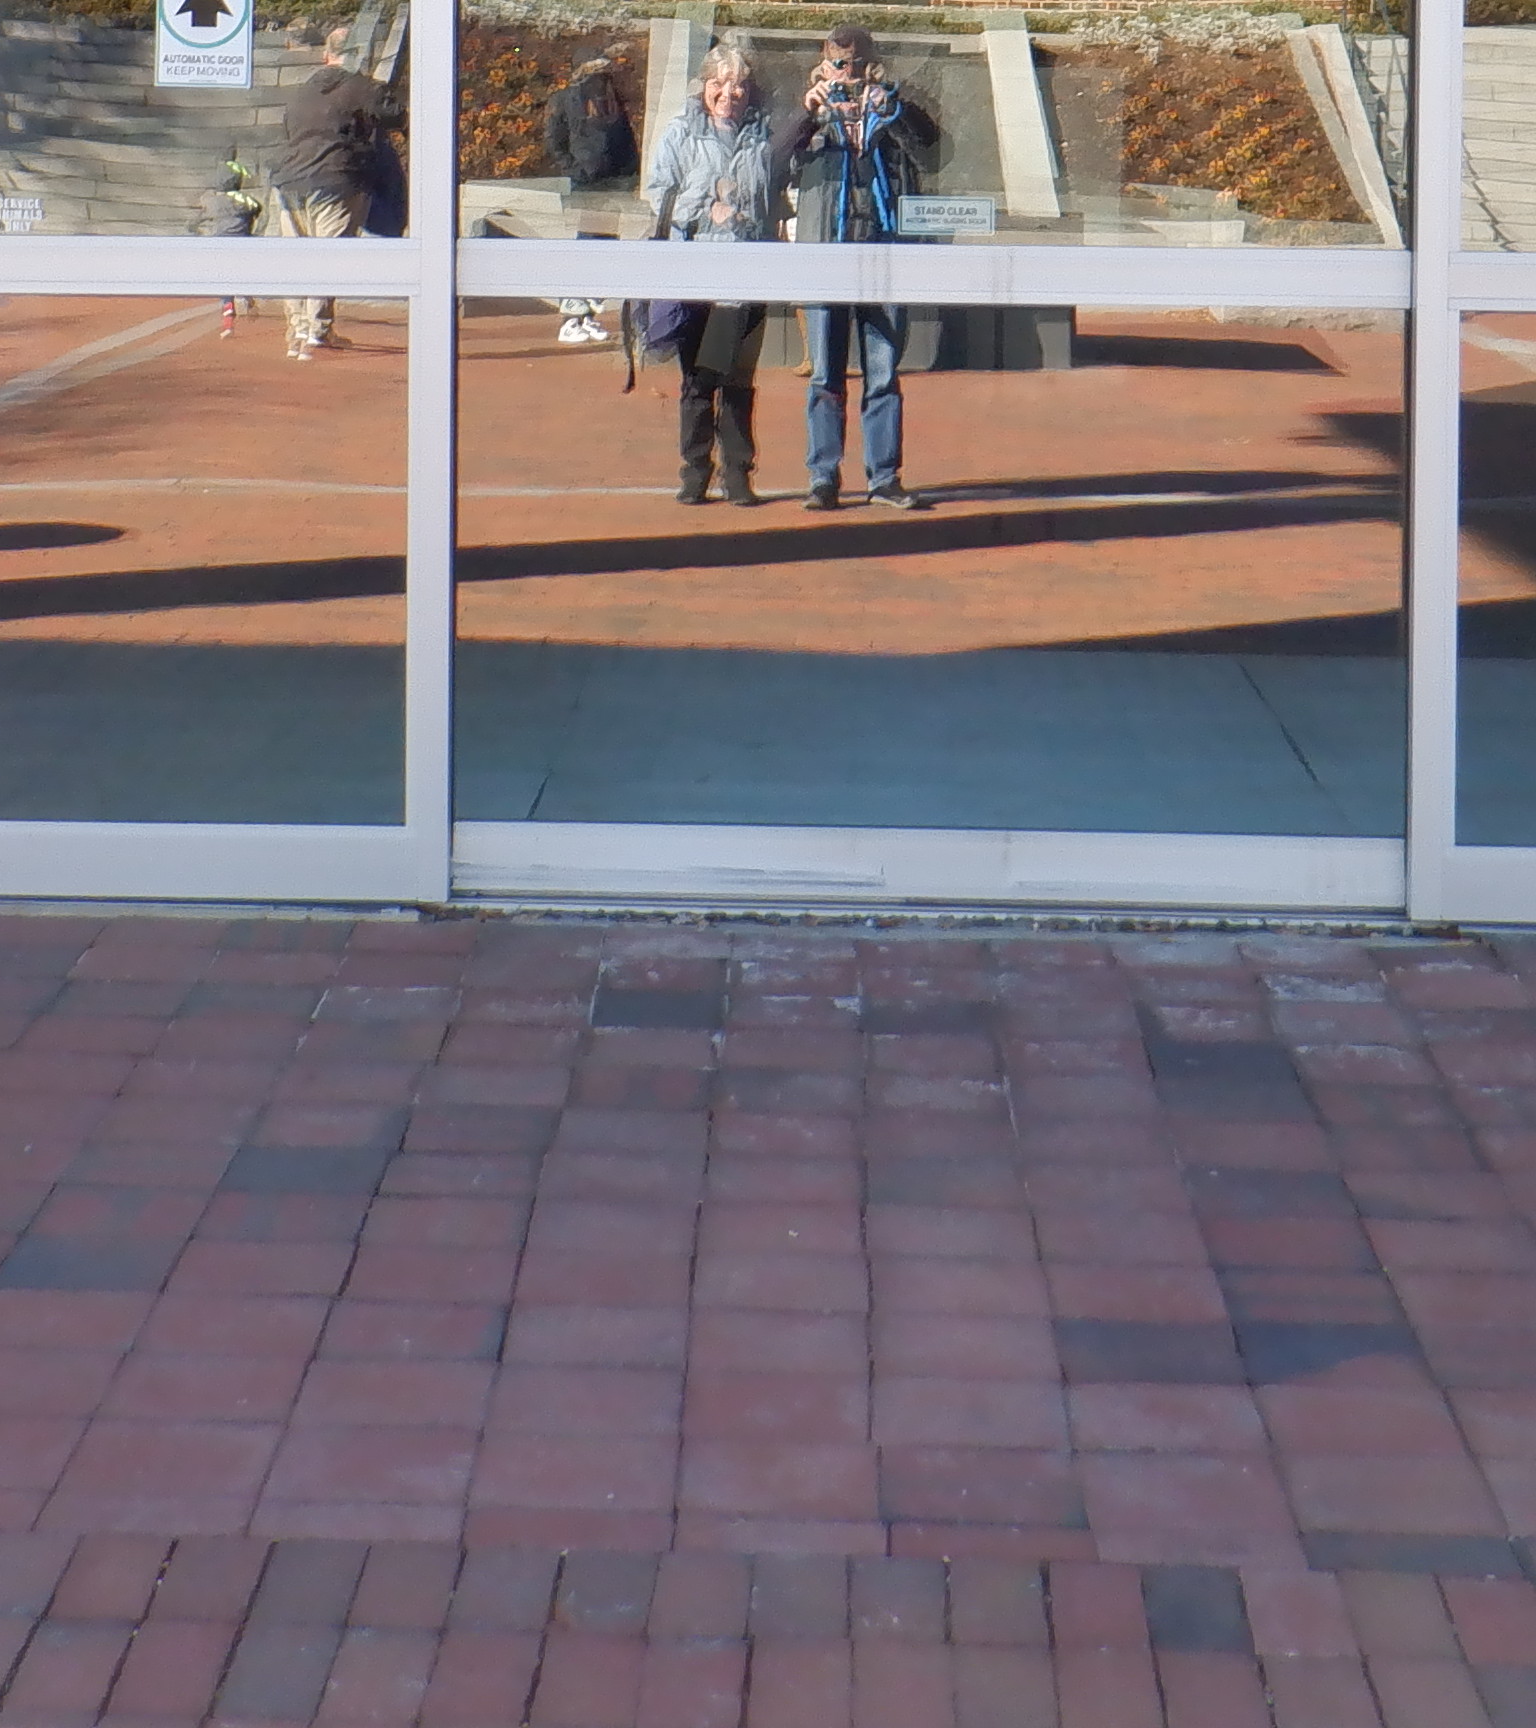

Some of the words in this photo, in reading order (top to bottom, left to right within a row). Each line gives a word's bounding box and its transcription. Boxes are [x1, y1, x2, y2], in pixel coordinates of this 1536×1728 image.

[162, 54, 216, 64] AUTOMATIC
[217, 55, 245, 65] DOOR
[166, 65, 196, 76] KEEP
[913, 205, 945, 216] STAND
[946, 206, 978, 216] CLEAR
